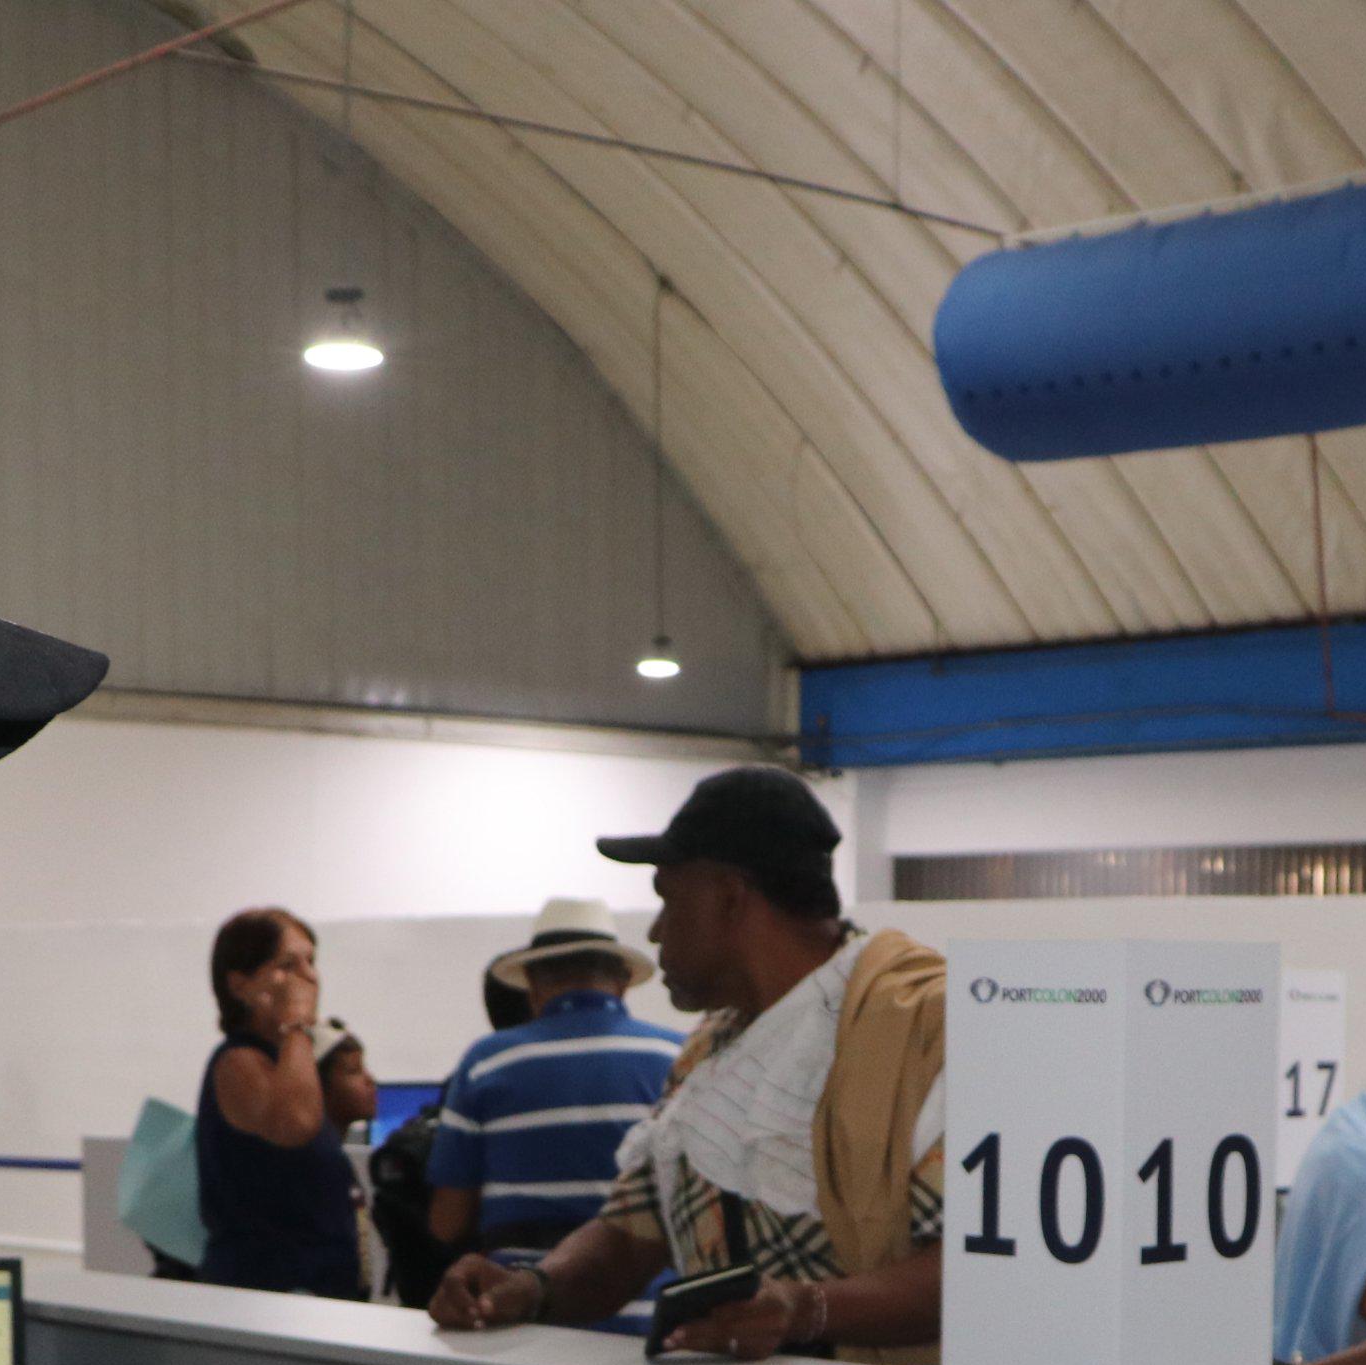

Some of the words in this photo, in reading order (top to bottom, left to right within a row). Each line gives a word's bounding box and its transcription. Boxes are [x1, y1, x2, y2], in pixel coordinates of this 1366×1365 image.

[1286, 1061, 1337, 1118] 17
[961, 1131, 1105, 1264] 10
[1137, 1132, 1262, 1265] 10
